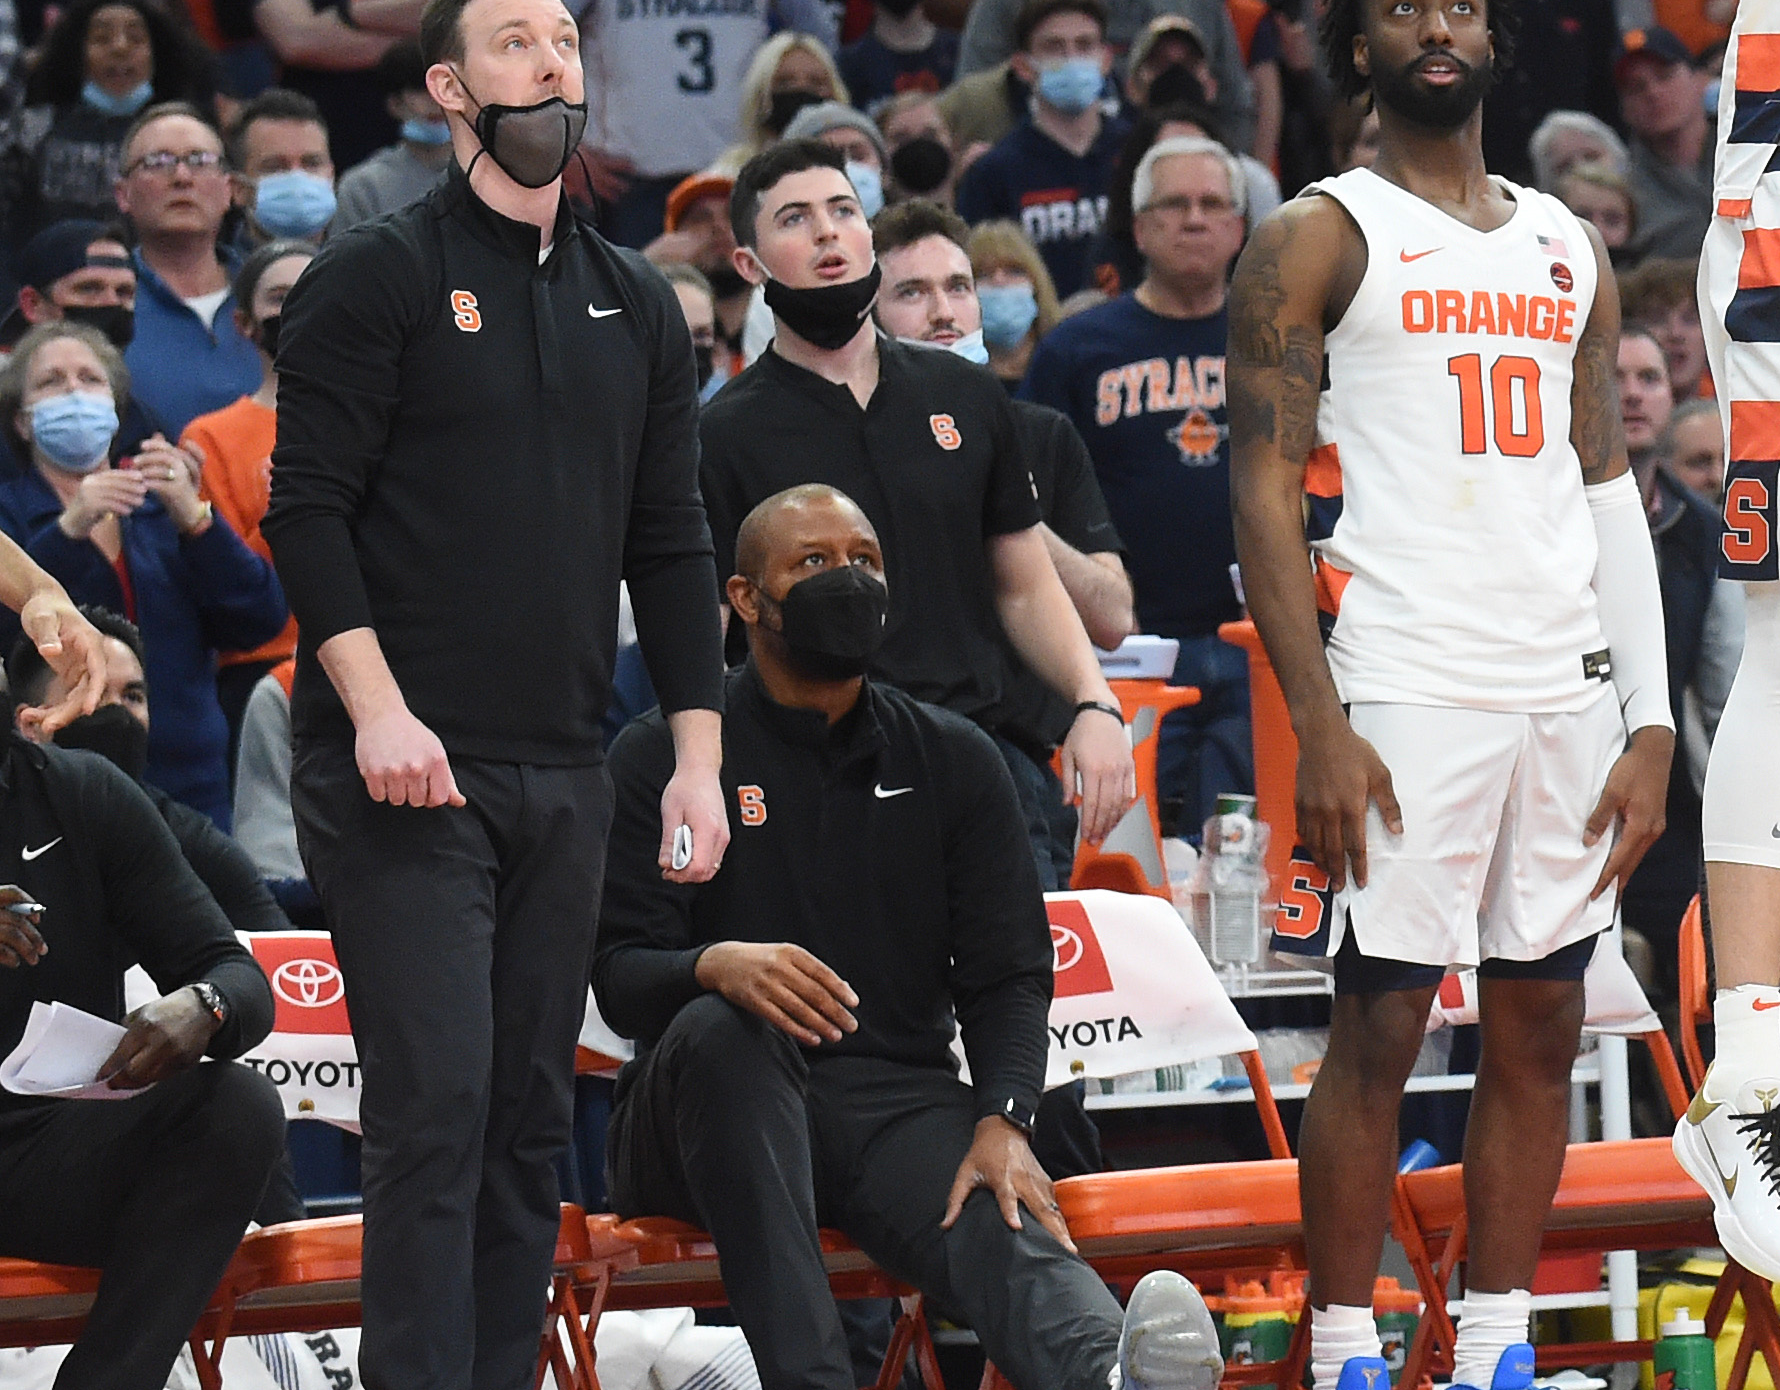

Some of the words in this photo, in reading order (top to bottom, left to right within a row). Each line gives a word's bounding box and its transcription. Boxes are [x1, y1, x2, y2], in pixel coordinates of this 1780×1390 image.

[675, 27, 715, 95] 3
[450, 289, 482, 333] S
[1401, 289, 1577, 344] ORANGE
[1095, 355, 1227, 427] SYRAC
[1447, 352, 1546, 459] 10
[929, 413, 962, 451] S
[1720, 477, 1771, 566] S
[737, 784, 767, 827] S
[1271, 858, 1331, 940] S
[1050, 1015, 1143, 1050] YOTA
[244, 1057, 362, 1088] TOYOT
